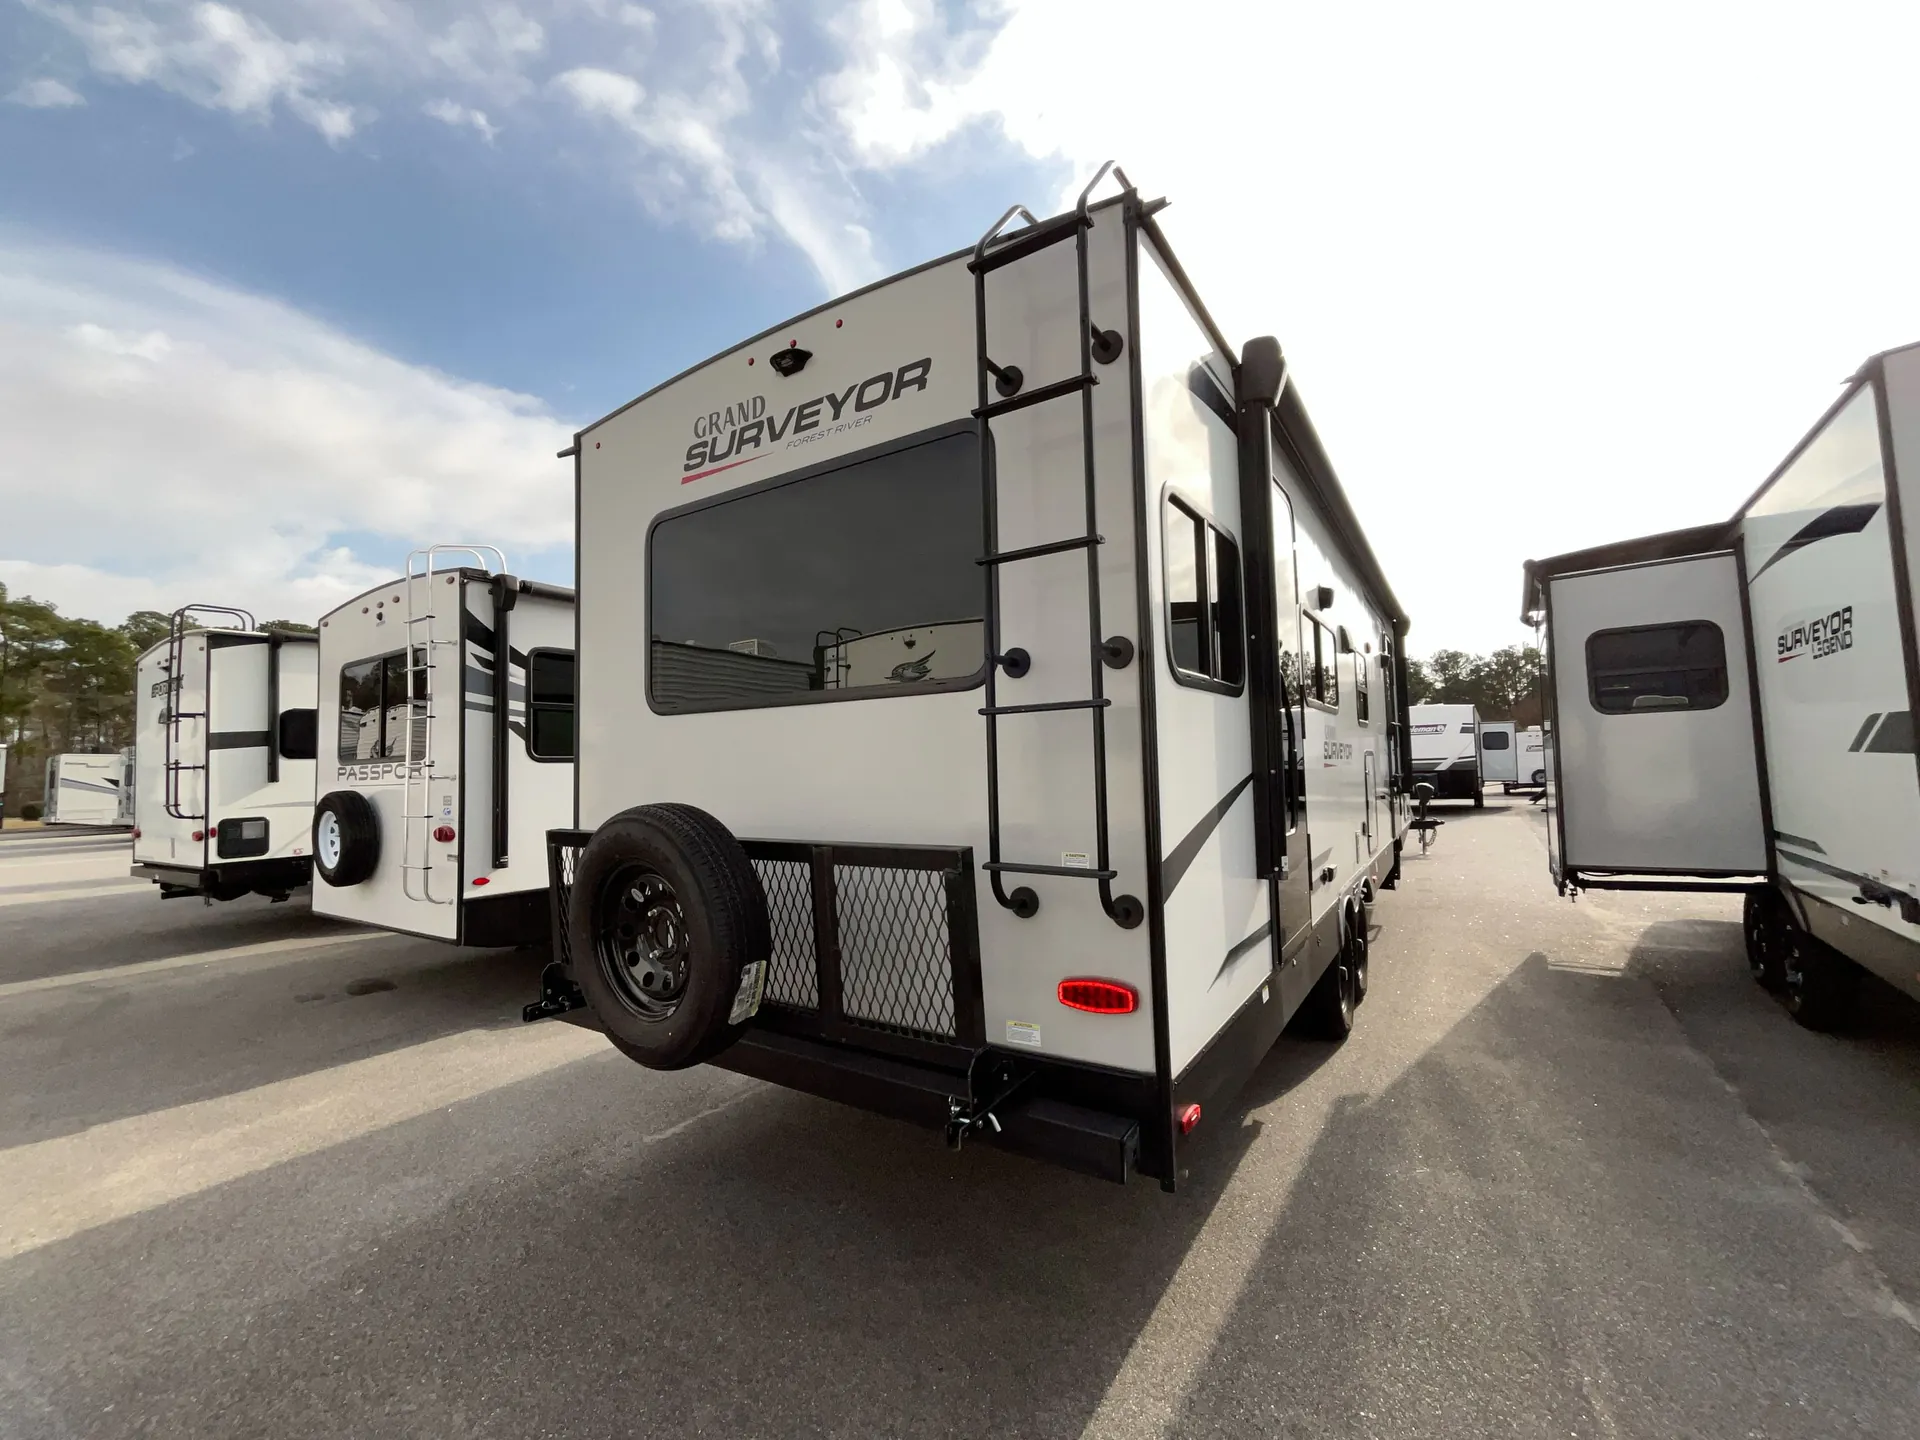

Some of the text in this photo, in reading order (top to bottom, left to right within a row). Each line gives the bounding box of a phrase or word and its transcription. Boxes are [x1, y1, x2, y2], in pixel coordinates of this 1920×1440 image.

[683, 357, 932, 472] SURVEYOR
[693, 395, 766, 439] GRAND
[785, 414, 873, 450] FOREST RIVER
[1777, 605, 1853, 655] SURVEYOR
[1811, 630, 1853, 660] LEGEND
